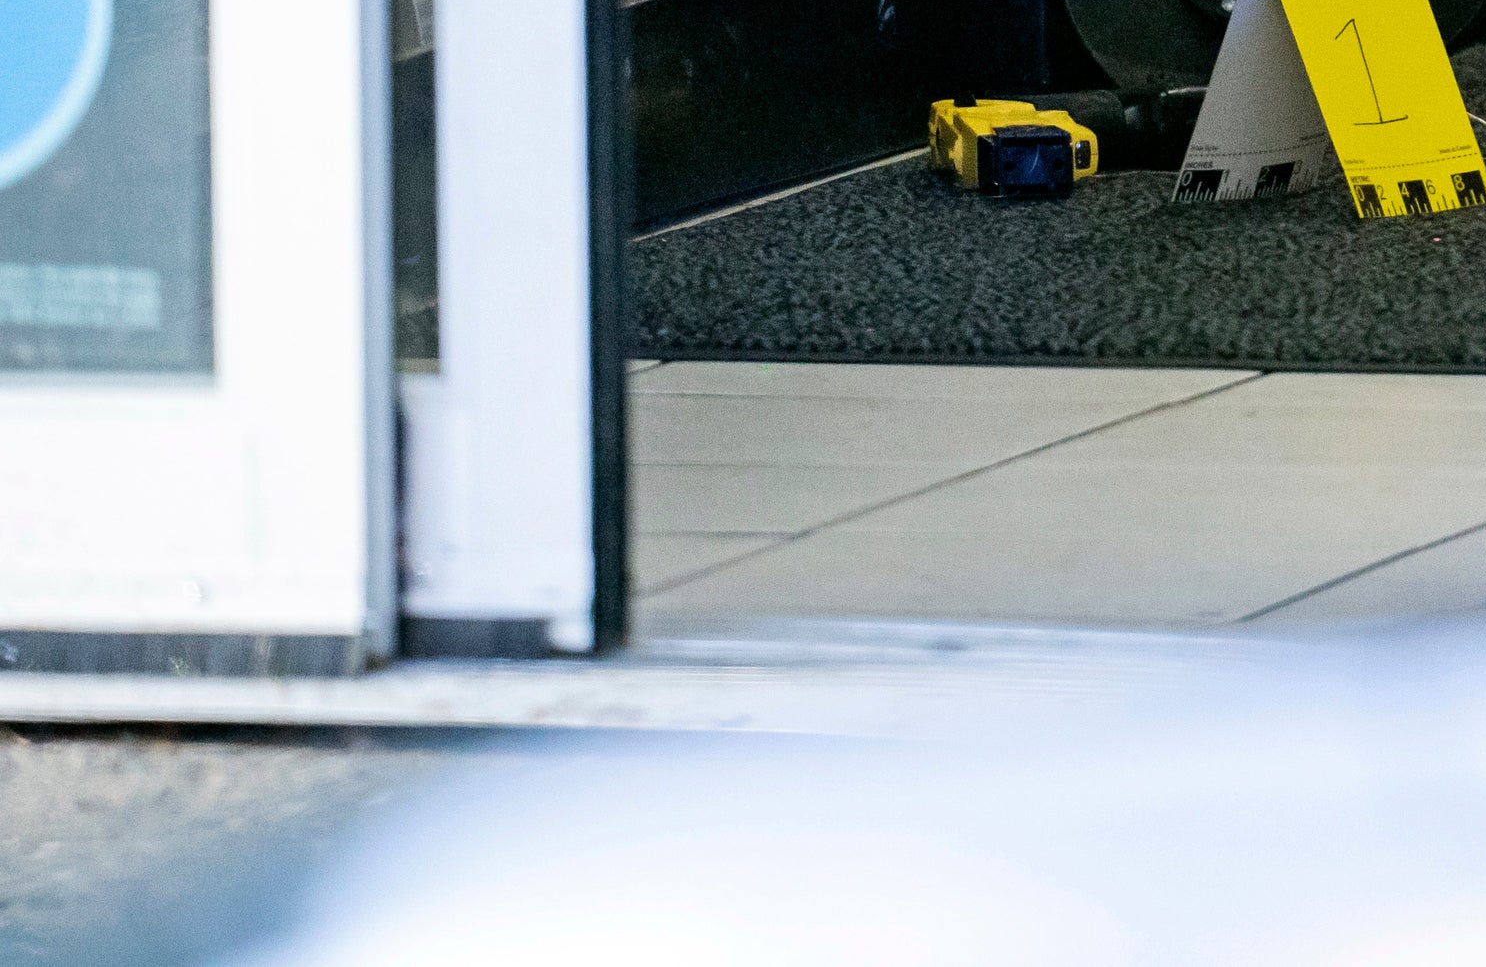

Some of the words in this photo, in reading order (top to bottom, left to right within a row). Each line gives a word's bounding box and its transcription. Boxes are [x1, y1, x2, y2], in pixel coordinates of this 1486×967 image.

[1335, 18, 1409, 126] 1
[1181, 170, 1193, 186] 0
[1257, 166, 1270, 182] 2
[1355, 187, 1365, 202] 0
[1376, 185, 1387, 200] 2
[1400, 182, 1410, 198] 4
[1425, 179, 1436, 195] 6
[1452, 174, 1465, 191] 8
